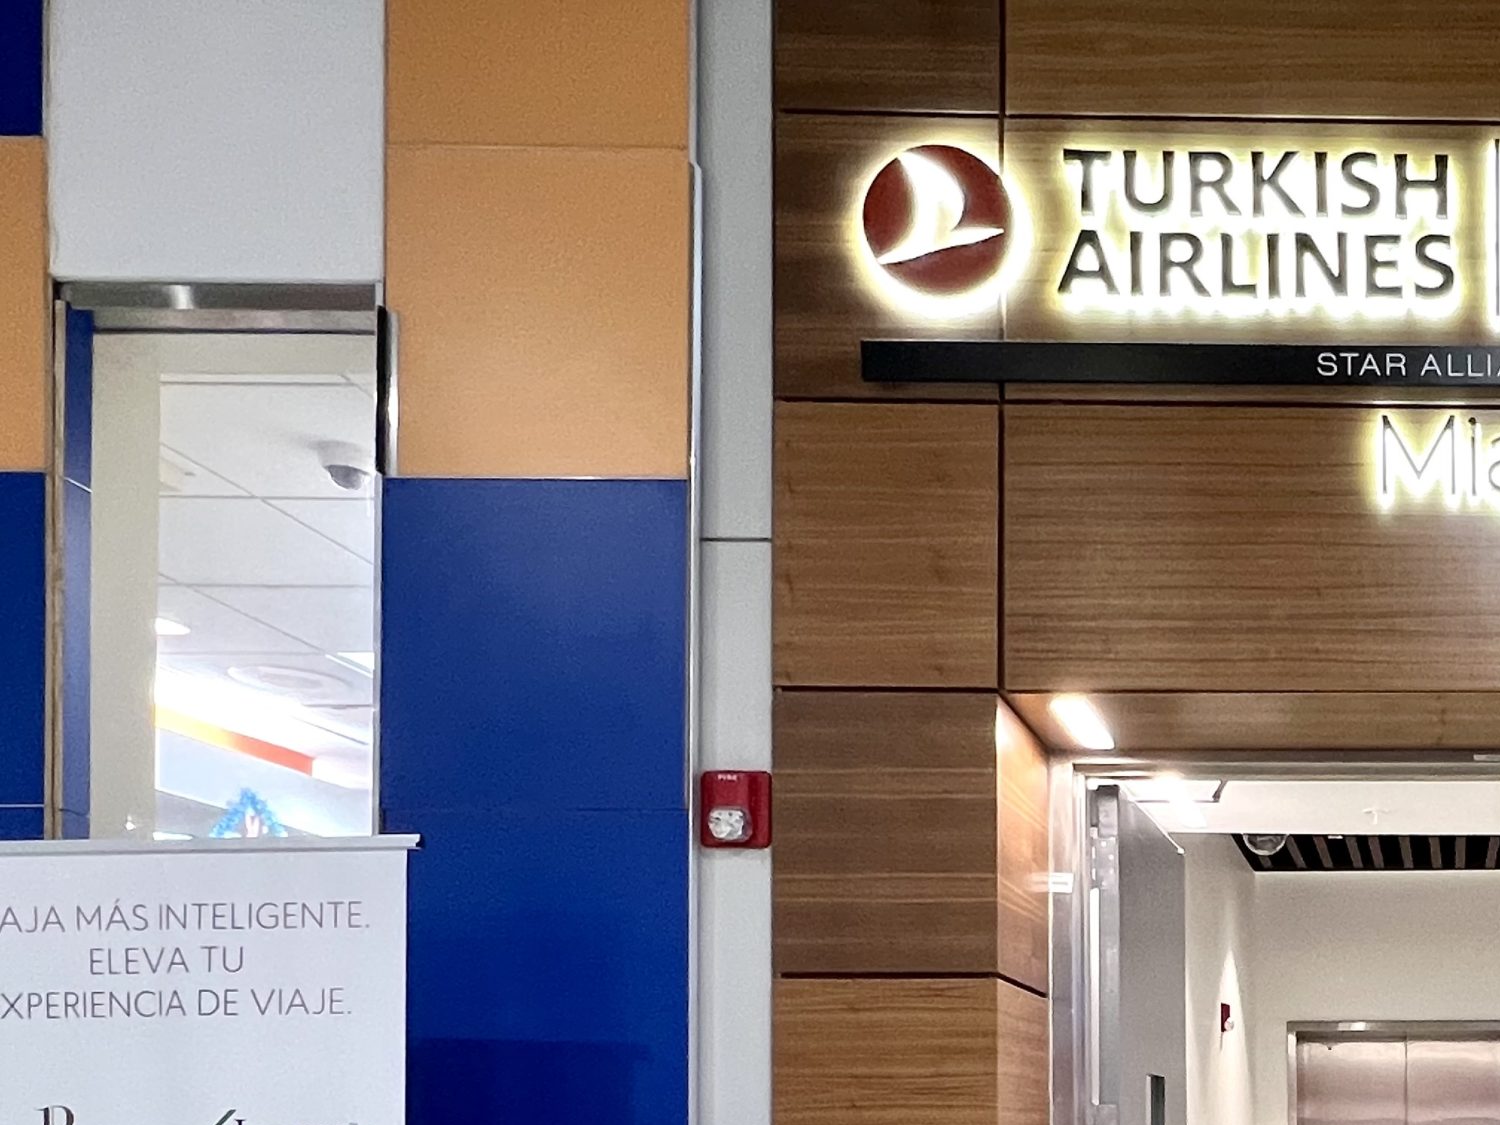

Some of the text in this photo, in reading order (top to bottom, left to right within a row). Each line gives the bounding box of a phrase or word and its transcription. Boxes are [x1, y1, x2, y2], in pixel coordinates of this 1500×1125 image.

[1063, 148, 1449, 220] TURKISH
[1057, 229, 1455, 299] AIRLINES
[1316, 351, 1407, 377] STAR
[76, 898, 149, 933] MÁS
[158, 900, 370, 931] INTELIGENTE.
[89, 945, 244, 976] ELEVA TU
[197, 988, 239, 1017] DE
[250, 987, 352, 1016] VIAJE.
